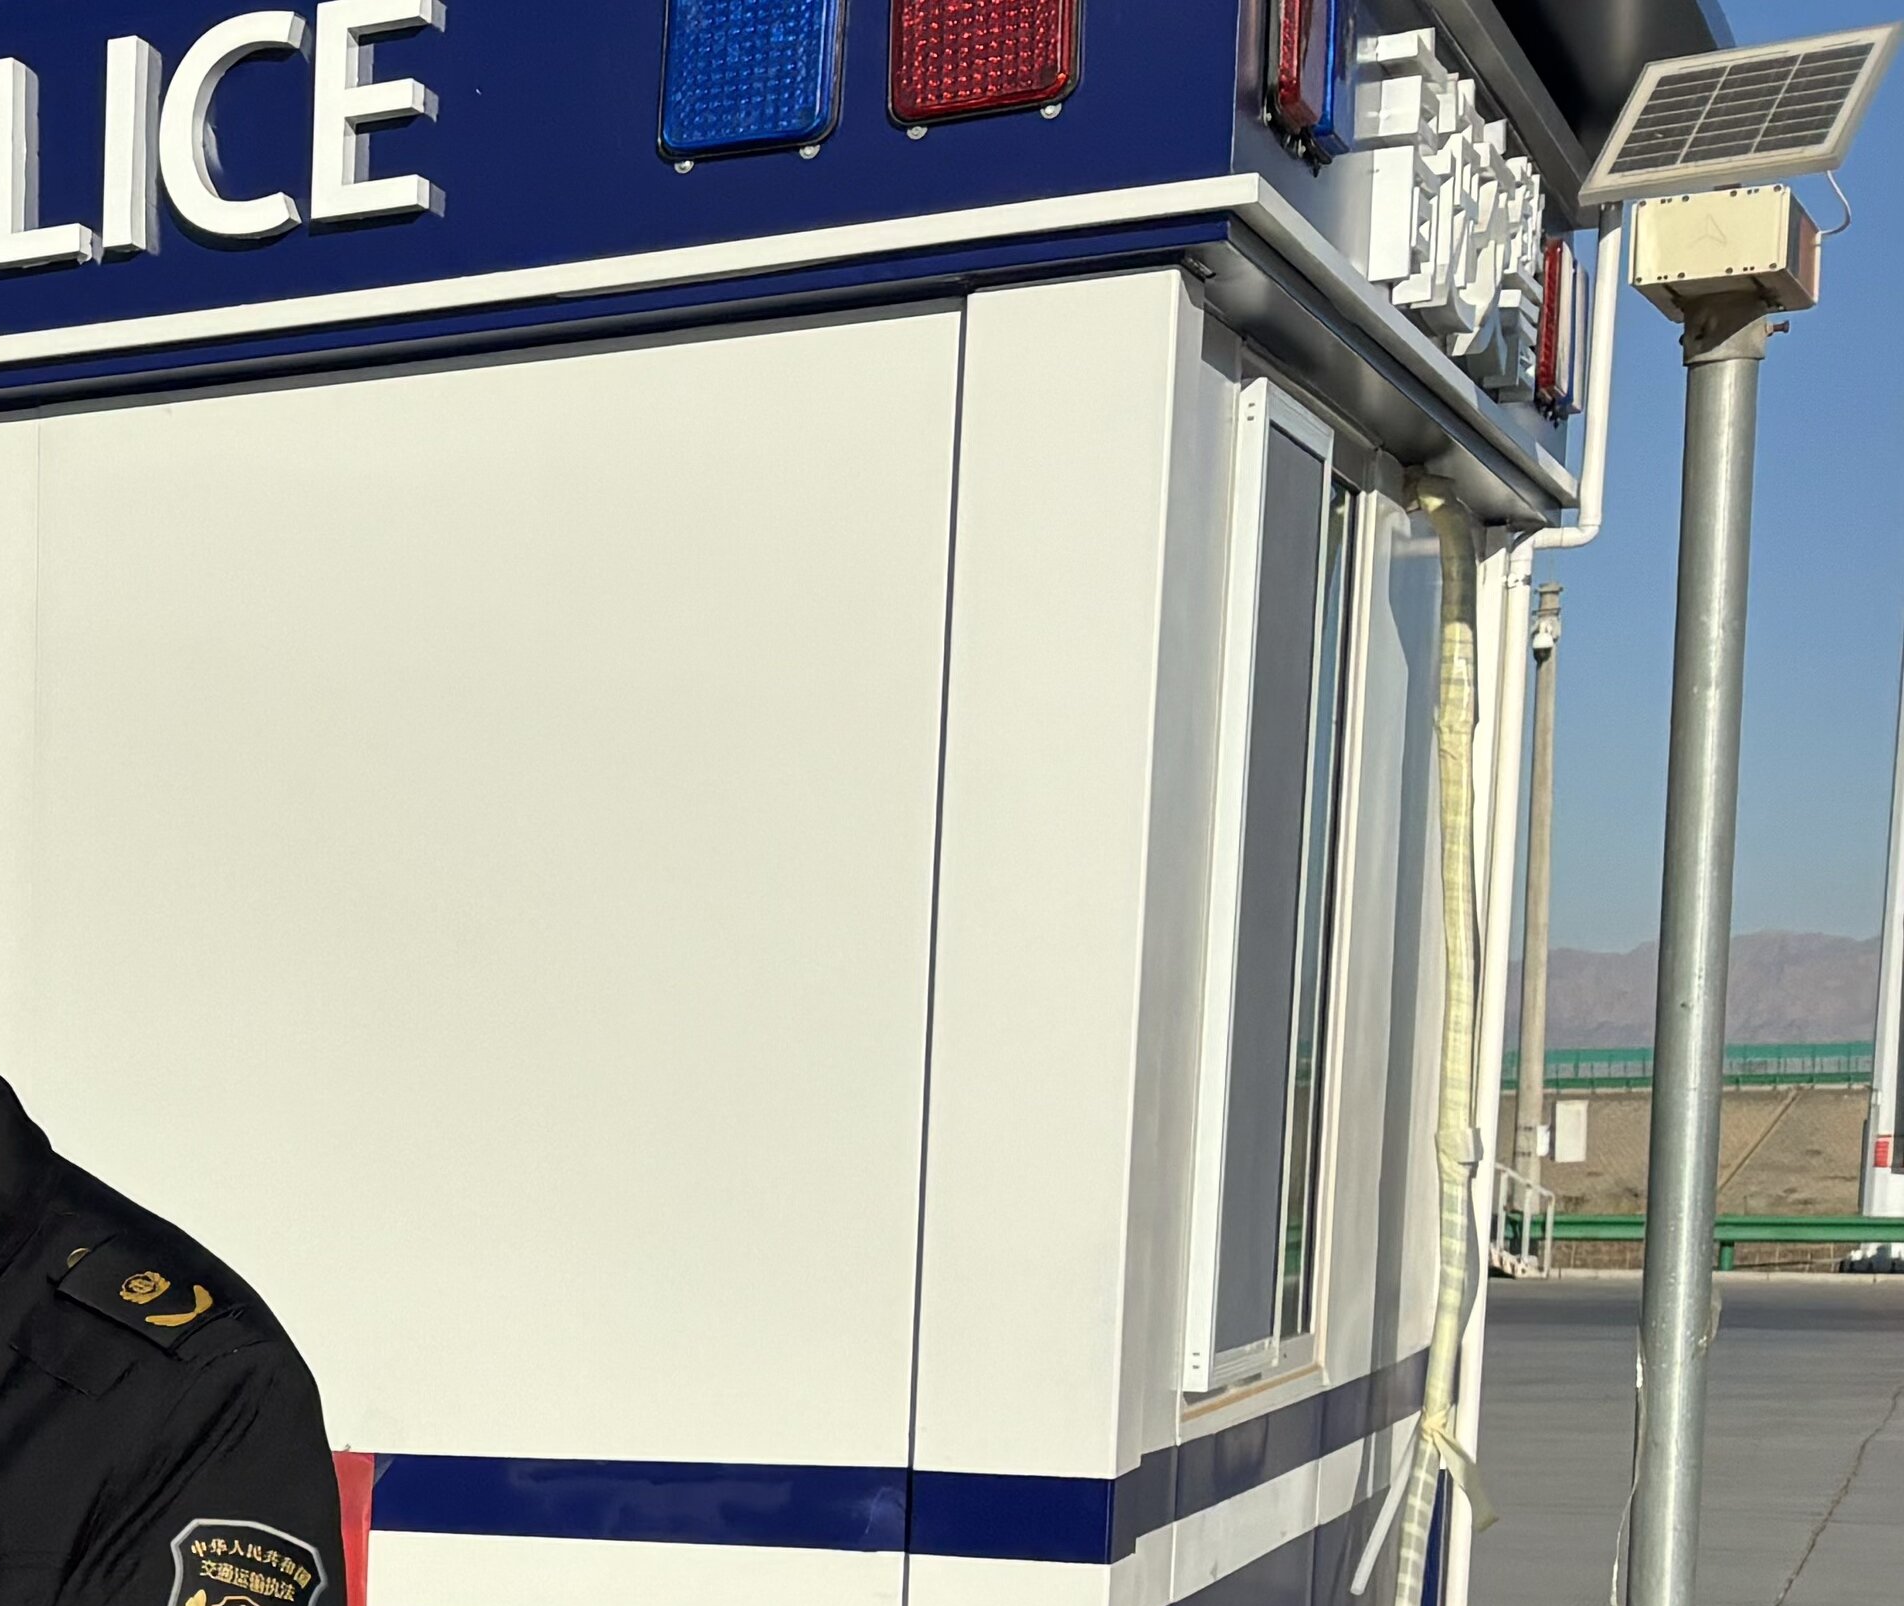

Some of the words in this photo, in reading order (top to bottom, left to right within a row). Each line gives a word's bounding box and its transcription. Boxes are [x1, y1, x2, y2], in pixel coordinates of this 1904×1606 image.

[191, 1538, 312, 1589] 中华人民共和国
[199, 1559, 296, 1602] 交通运输执法
